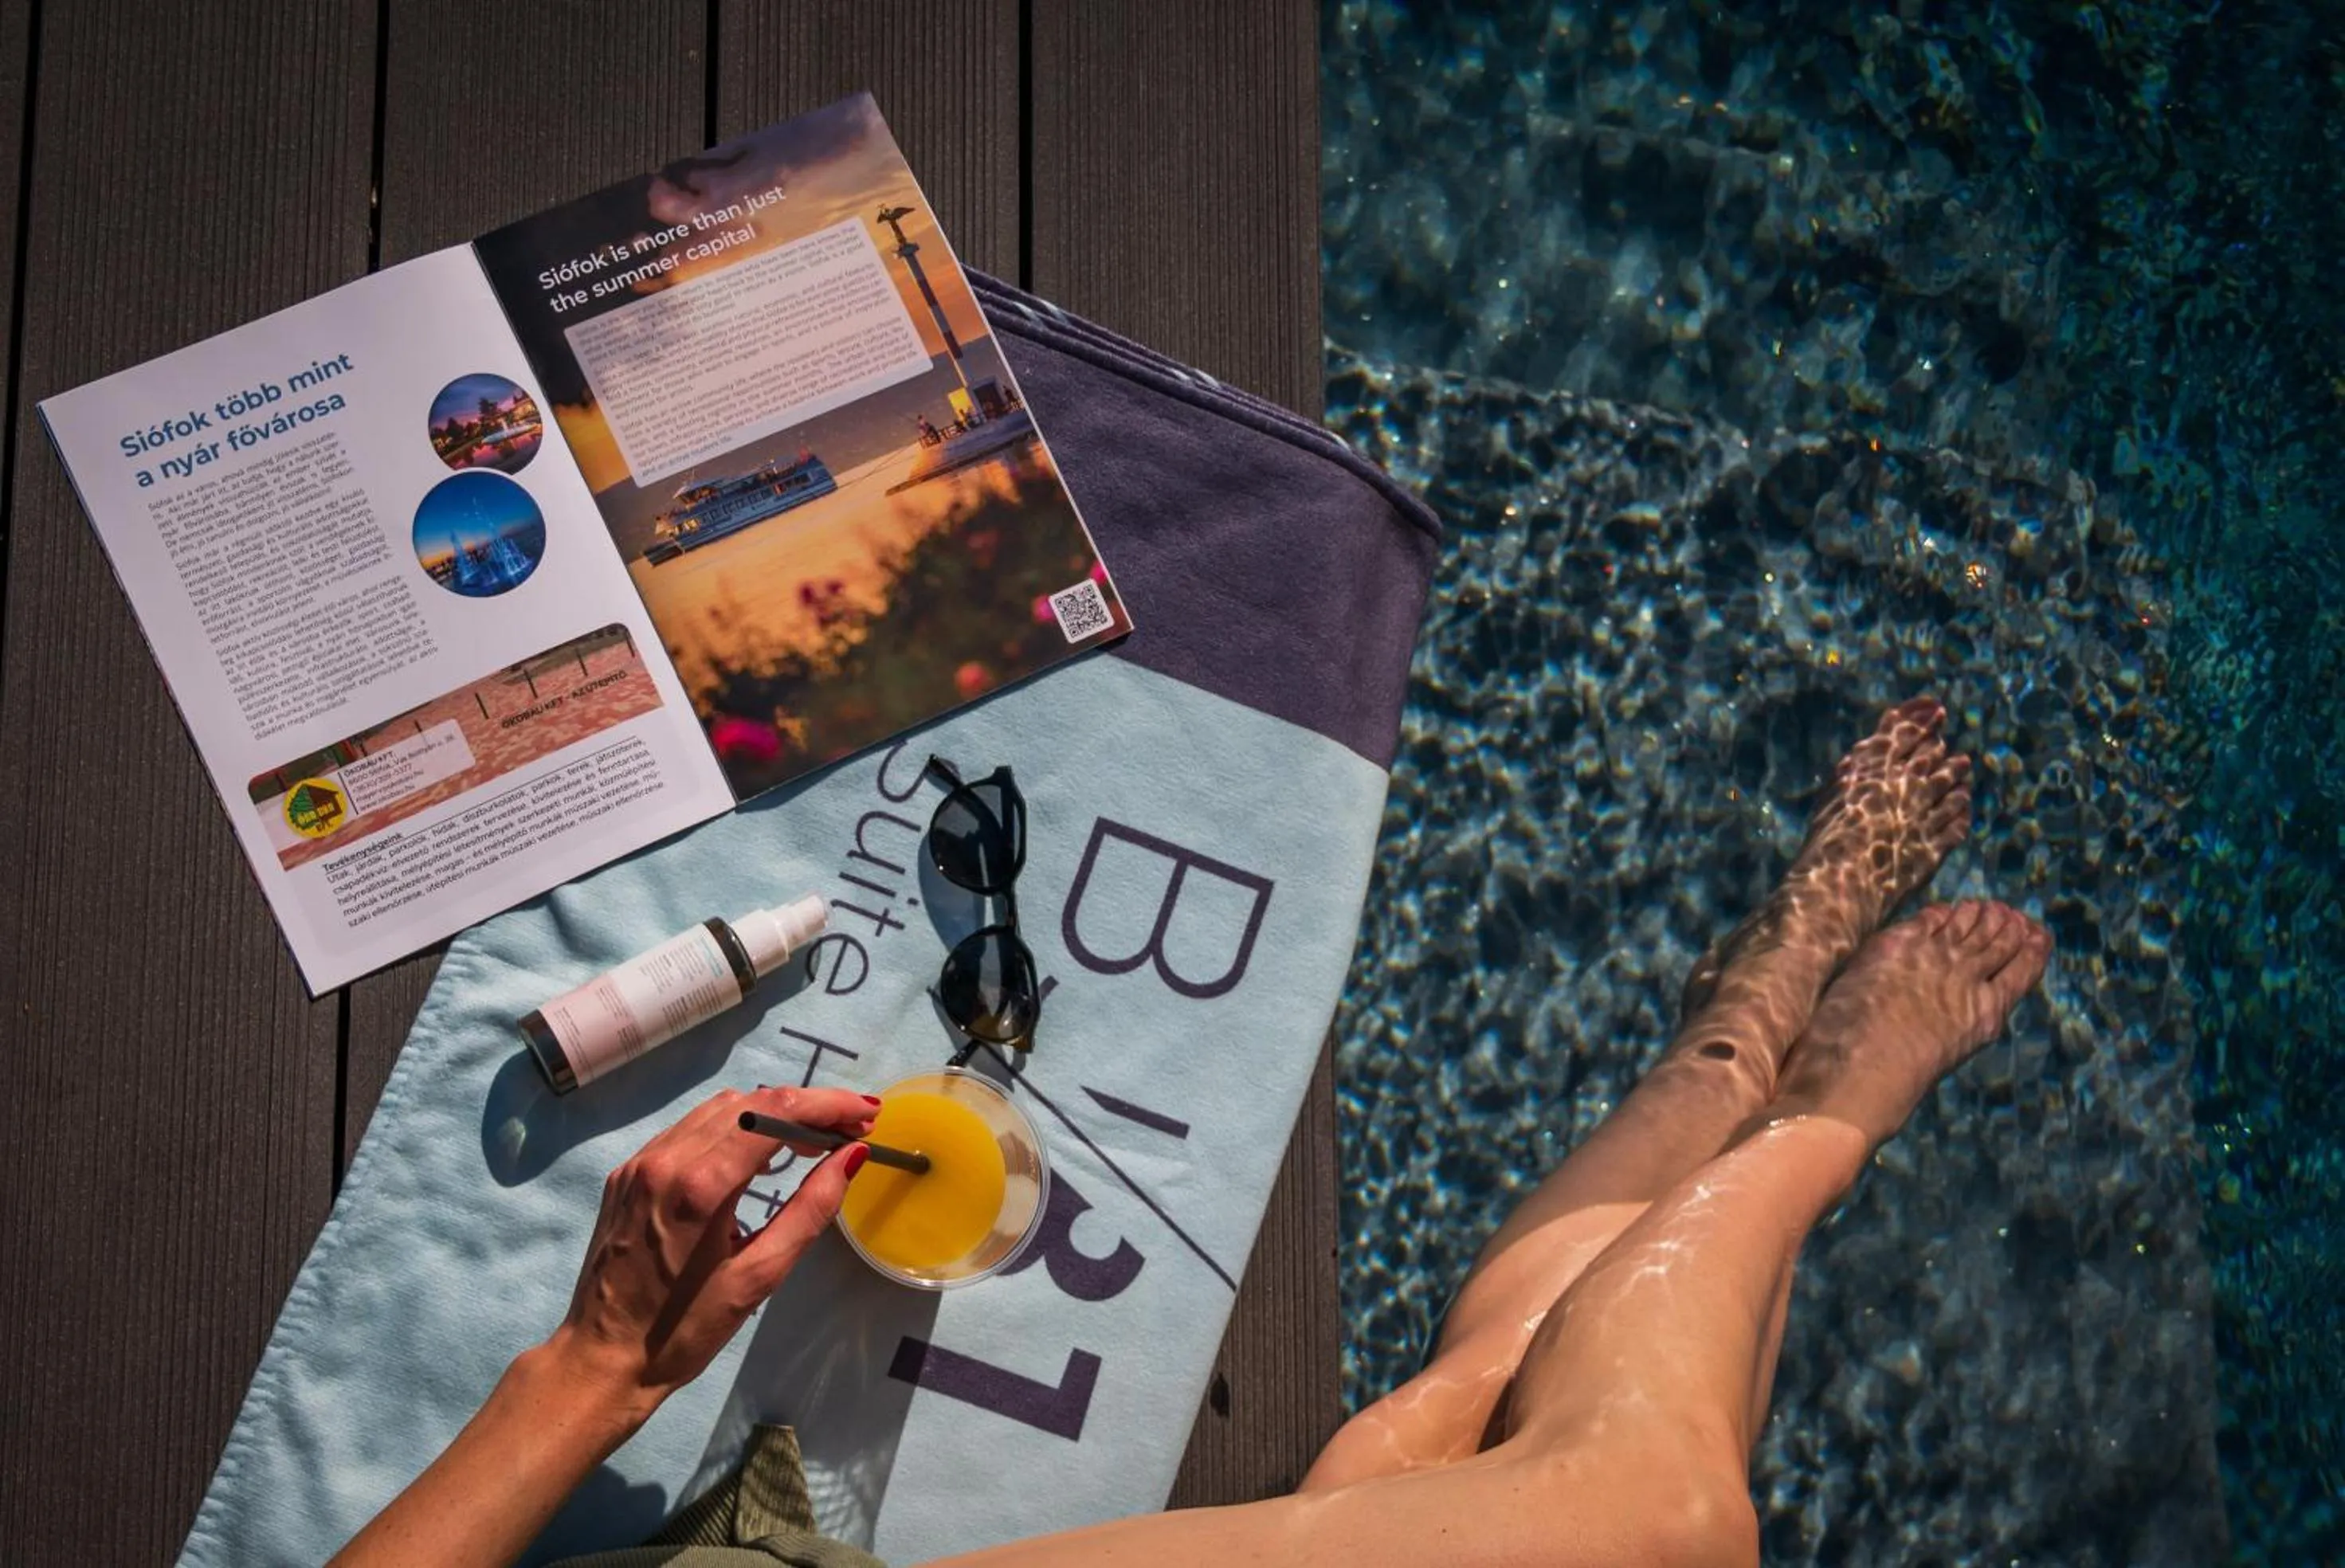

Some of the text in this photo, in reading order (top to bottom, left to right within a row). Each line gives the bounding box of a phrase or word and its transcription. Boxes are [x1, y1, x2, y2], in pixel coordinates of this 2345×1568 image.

[539, 186, 786, 289] Siófok is more than just
[550, 291, 588, 312] the
[592, 253, 679, 297] summer
[686, 223, 755, 260] capital
[120, 355, 354, 457] Siófok több mint
[135, 394, 346, 487] a nyár fővárosa
